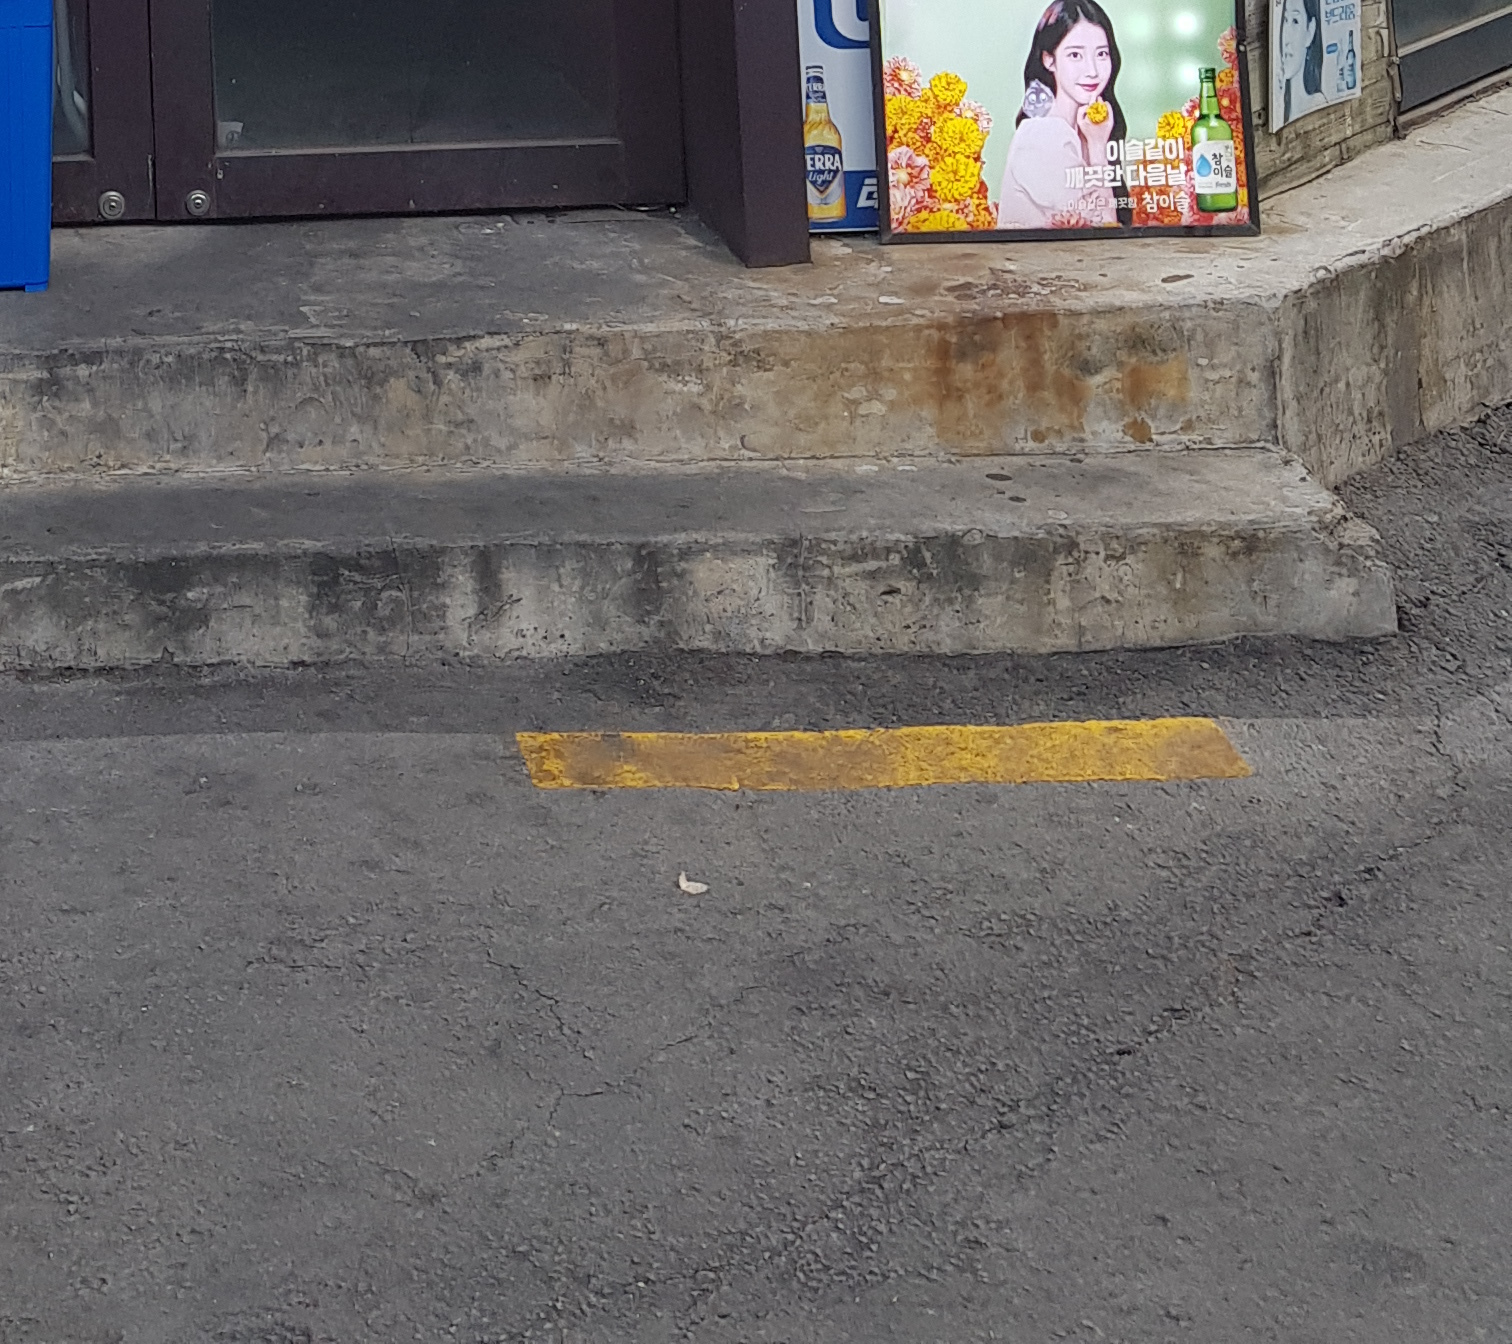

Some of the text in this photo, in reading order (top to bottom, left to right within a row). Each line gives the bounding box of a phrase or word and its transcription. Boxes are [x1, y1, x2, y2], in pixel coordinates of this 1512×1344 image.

[1106, 137, 1184, 162] 이슬같이
[1211, 153, 1223, 166] 참
[808, 172, 834, 185] Light
[1065, 163, 1187, 188] 깨끗한 다음날
[1142, 191, 1190, 212] 참이슬
